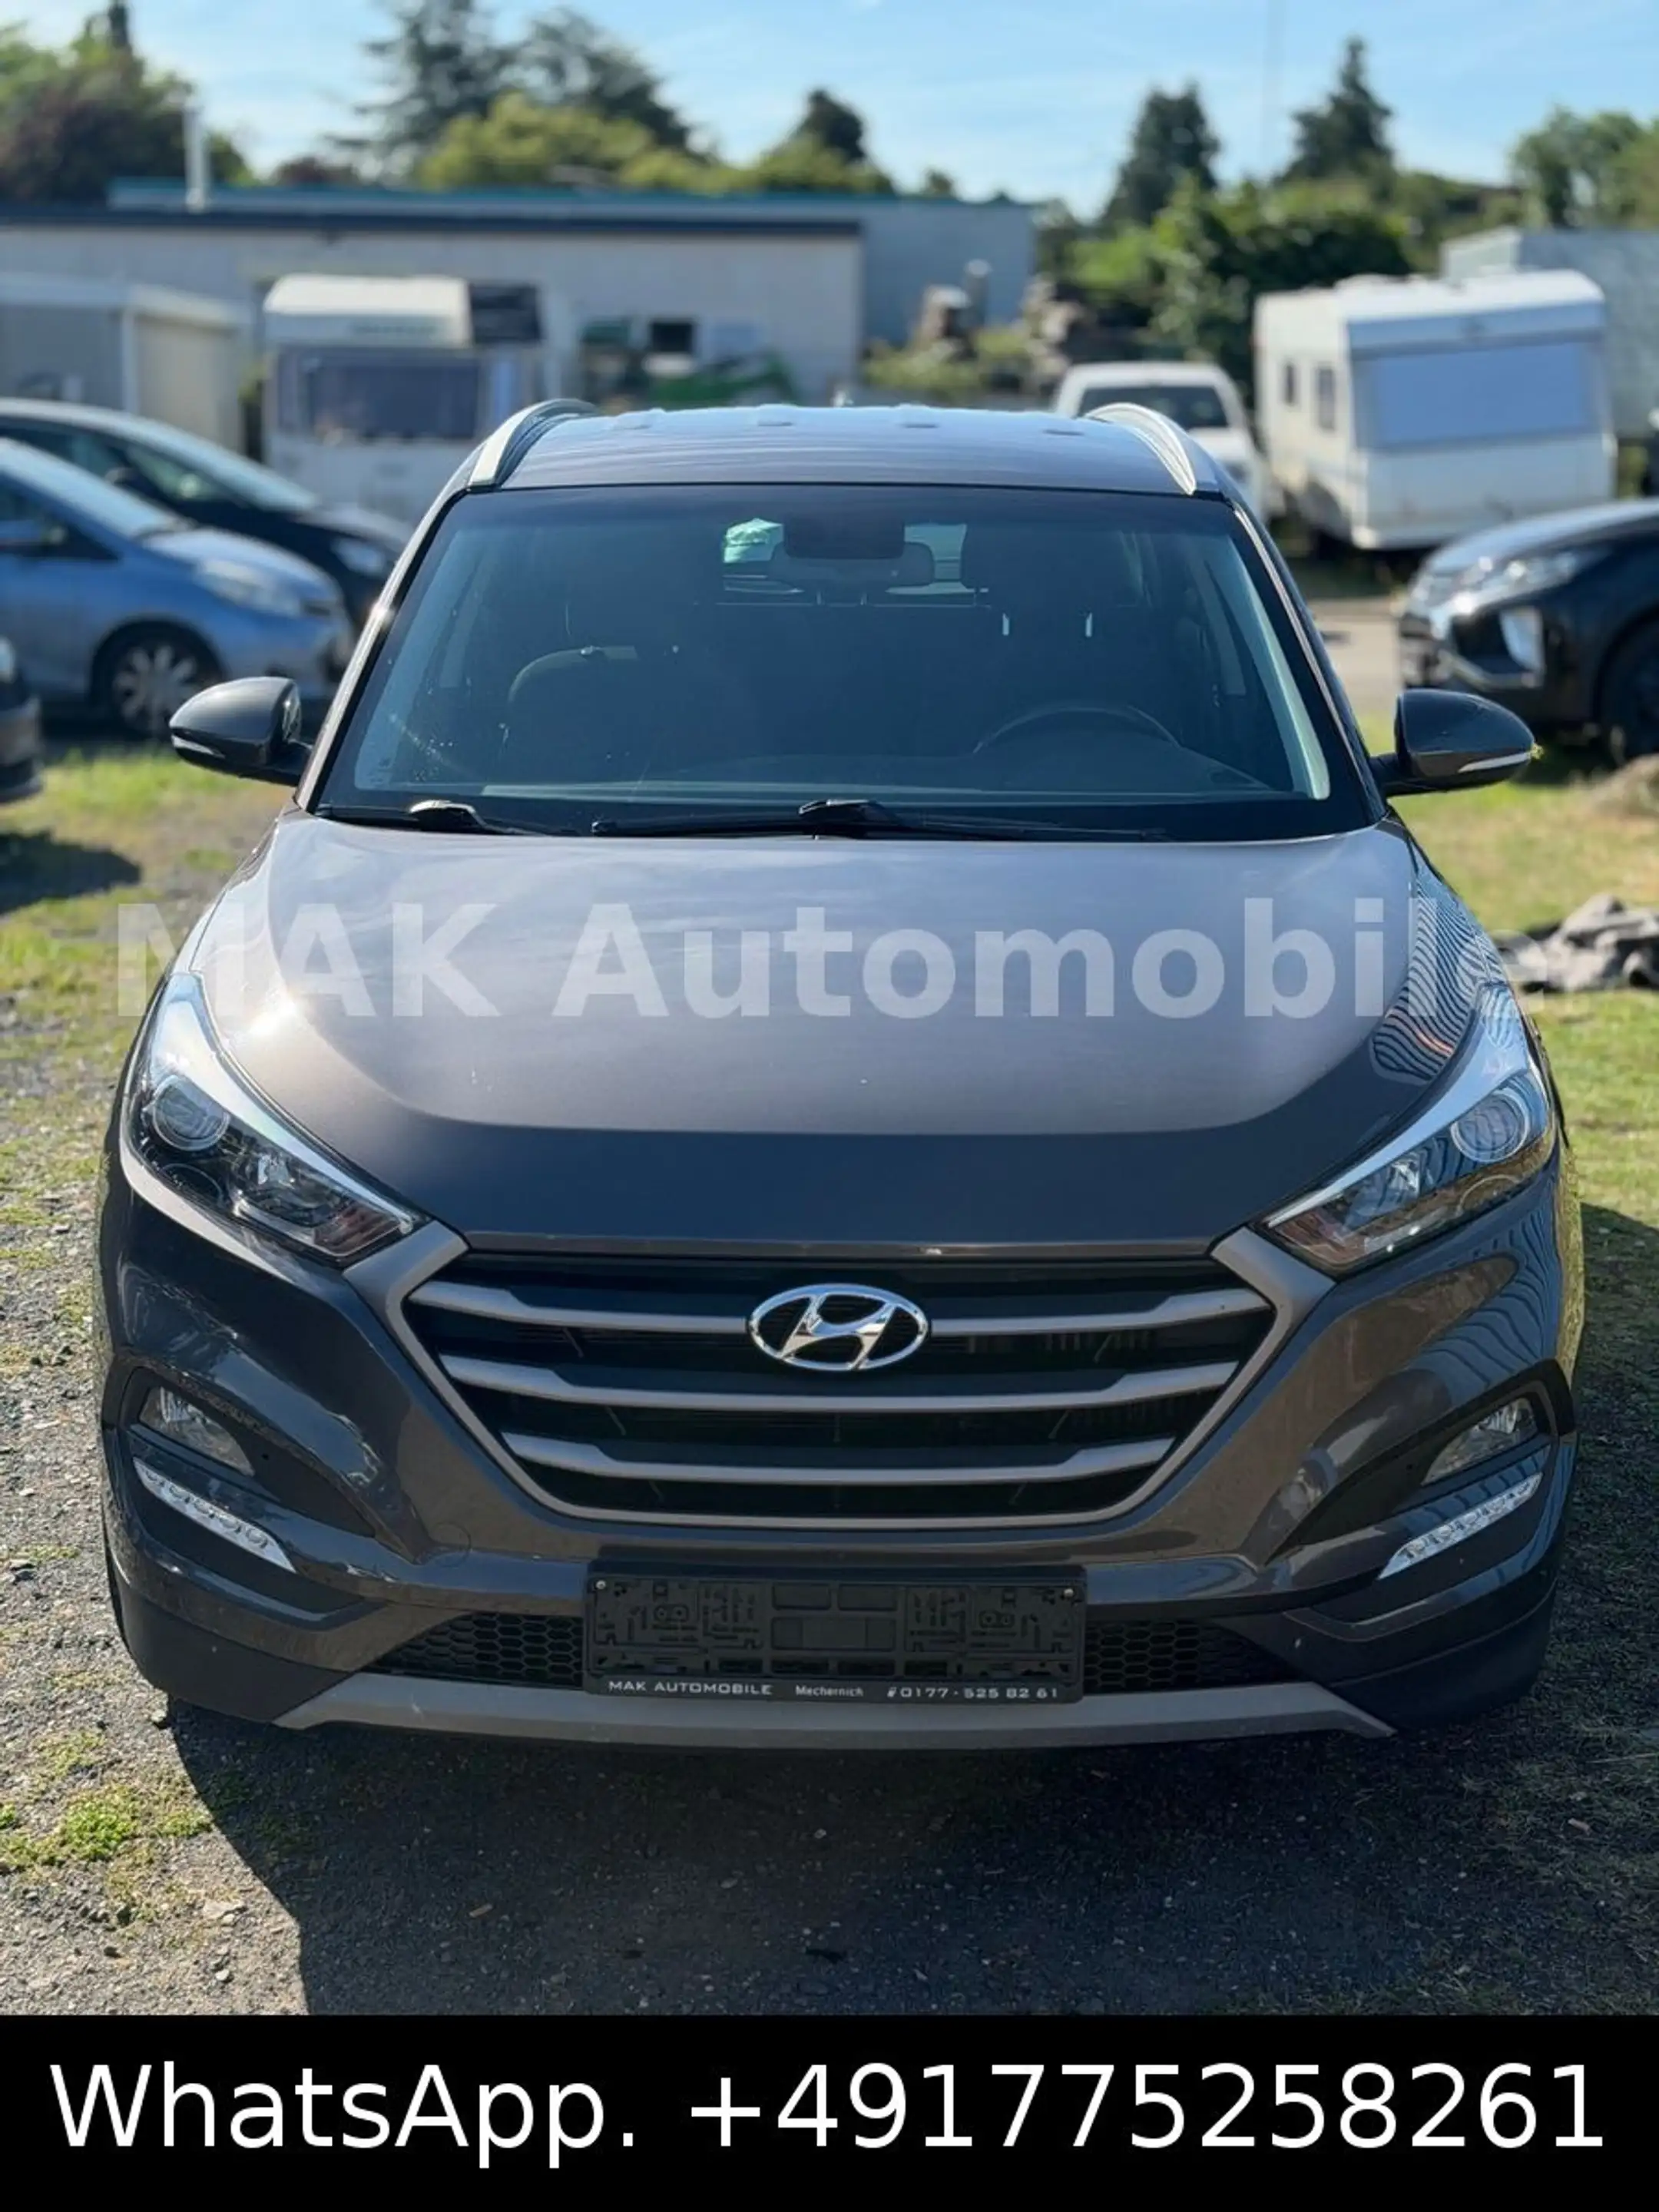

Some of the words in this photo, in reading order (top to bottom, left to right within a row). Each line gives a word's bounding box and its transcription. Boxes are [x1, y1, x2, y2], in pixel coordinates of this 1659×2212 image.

[609, 1681, 646, 1692] MAK
[654, 1681, 773, 1695] AUTOMOBILE
[900, 1687, 949, 1697] 0177
